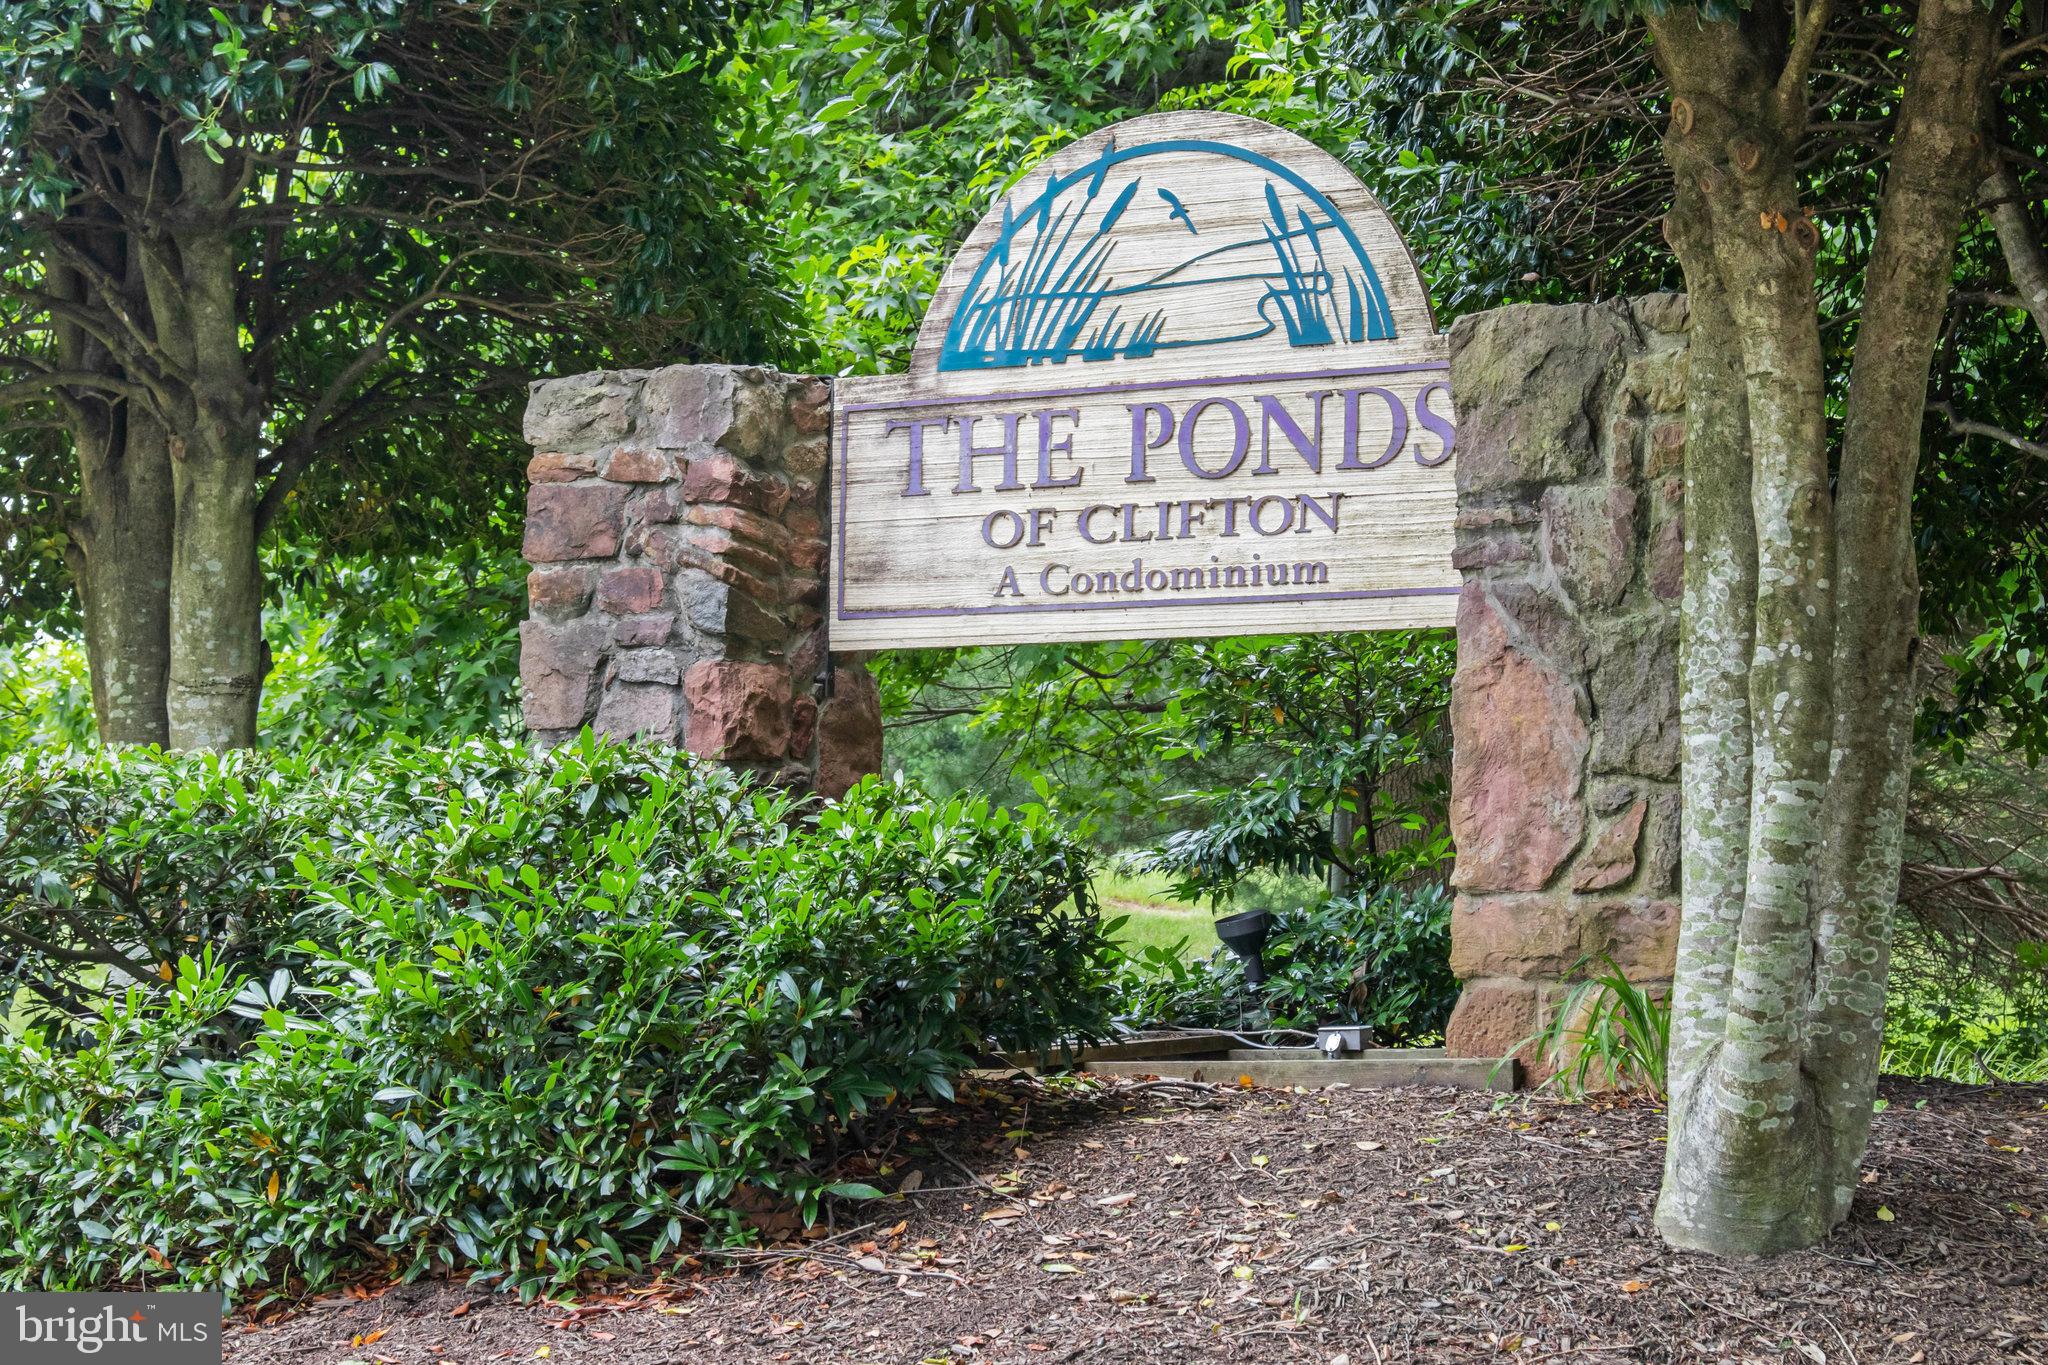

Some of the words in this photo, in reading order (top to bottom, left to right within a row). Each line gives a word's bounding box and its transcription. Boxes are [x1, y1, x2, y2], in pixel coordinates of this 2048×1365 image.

[885, 407, 1084, 498] THE
[1124, 381, 1457, 483] PONDS
[981, 507, 1058, 549] OF
[1077, 491, 1346, 545] CLIFTON
[993, 564, 1025, 598] A
[1040, 553, 1330, 596] Condominium
